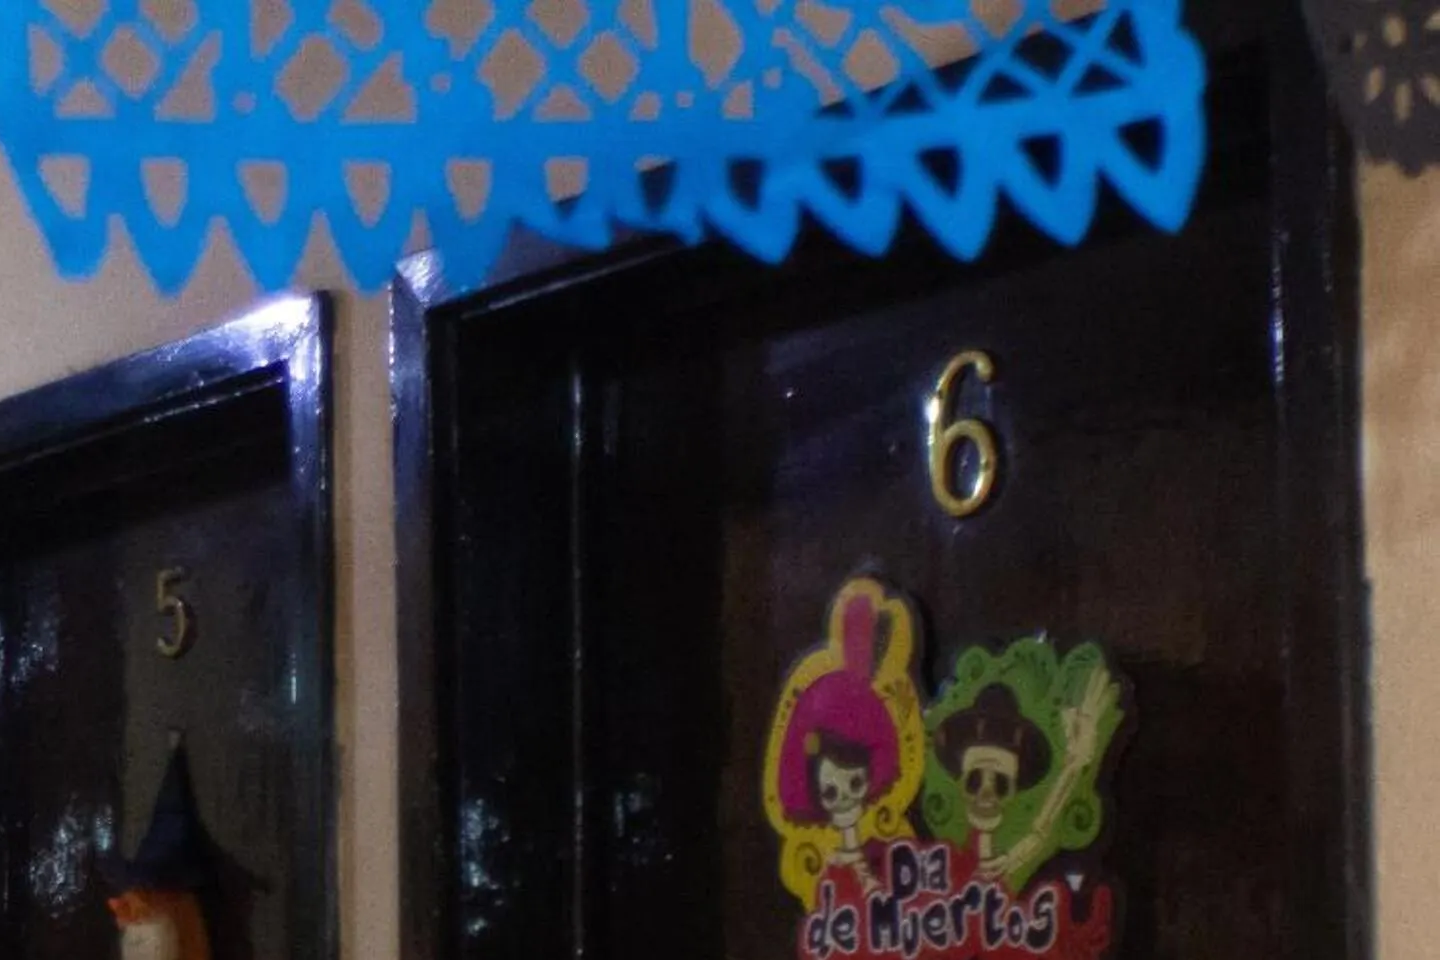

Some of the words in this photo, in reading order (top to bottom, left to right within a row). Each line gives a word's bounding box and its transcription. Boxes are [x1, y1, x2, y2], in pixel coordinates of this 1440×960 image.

[926, 349, 997, 516] 6
[156, 566, 191, 657] 5
[806, 880, 858, 960] de
[868, 881, 1057, 959] Muertos
